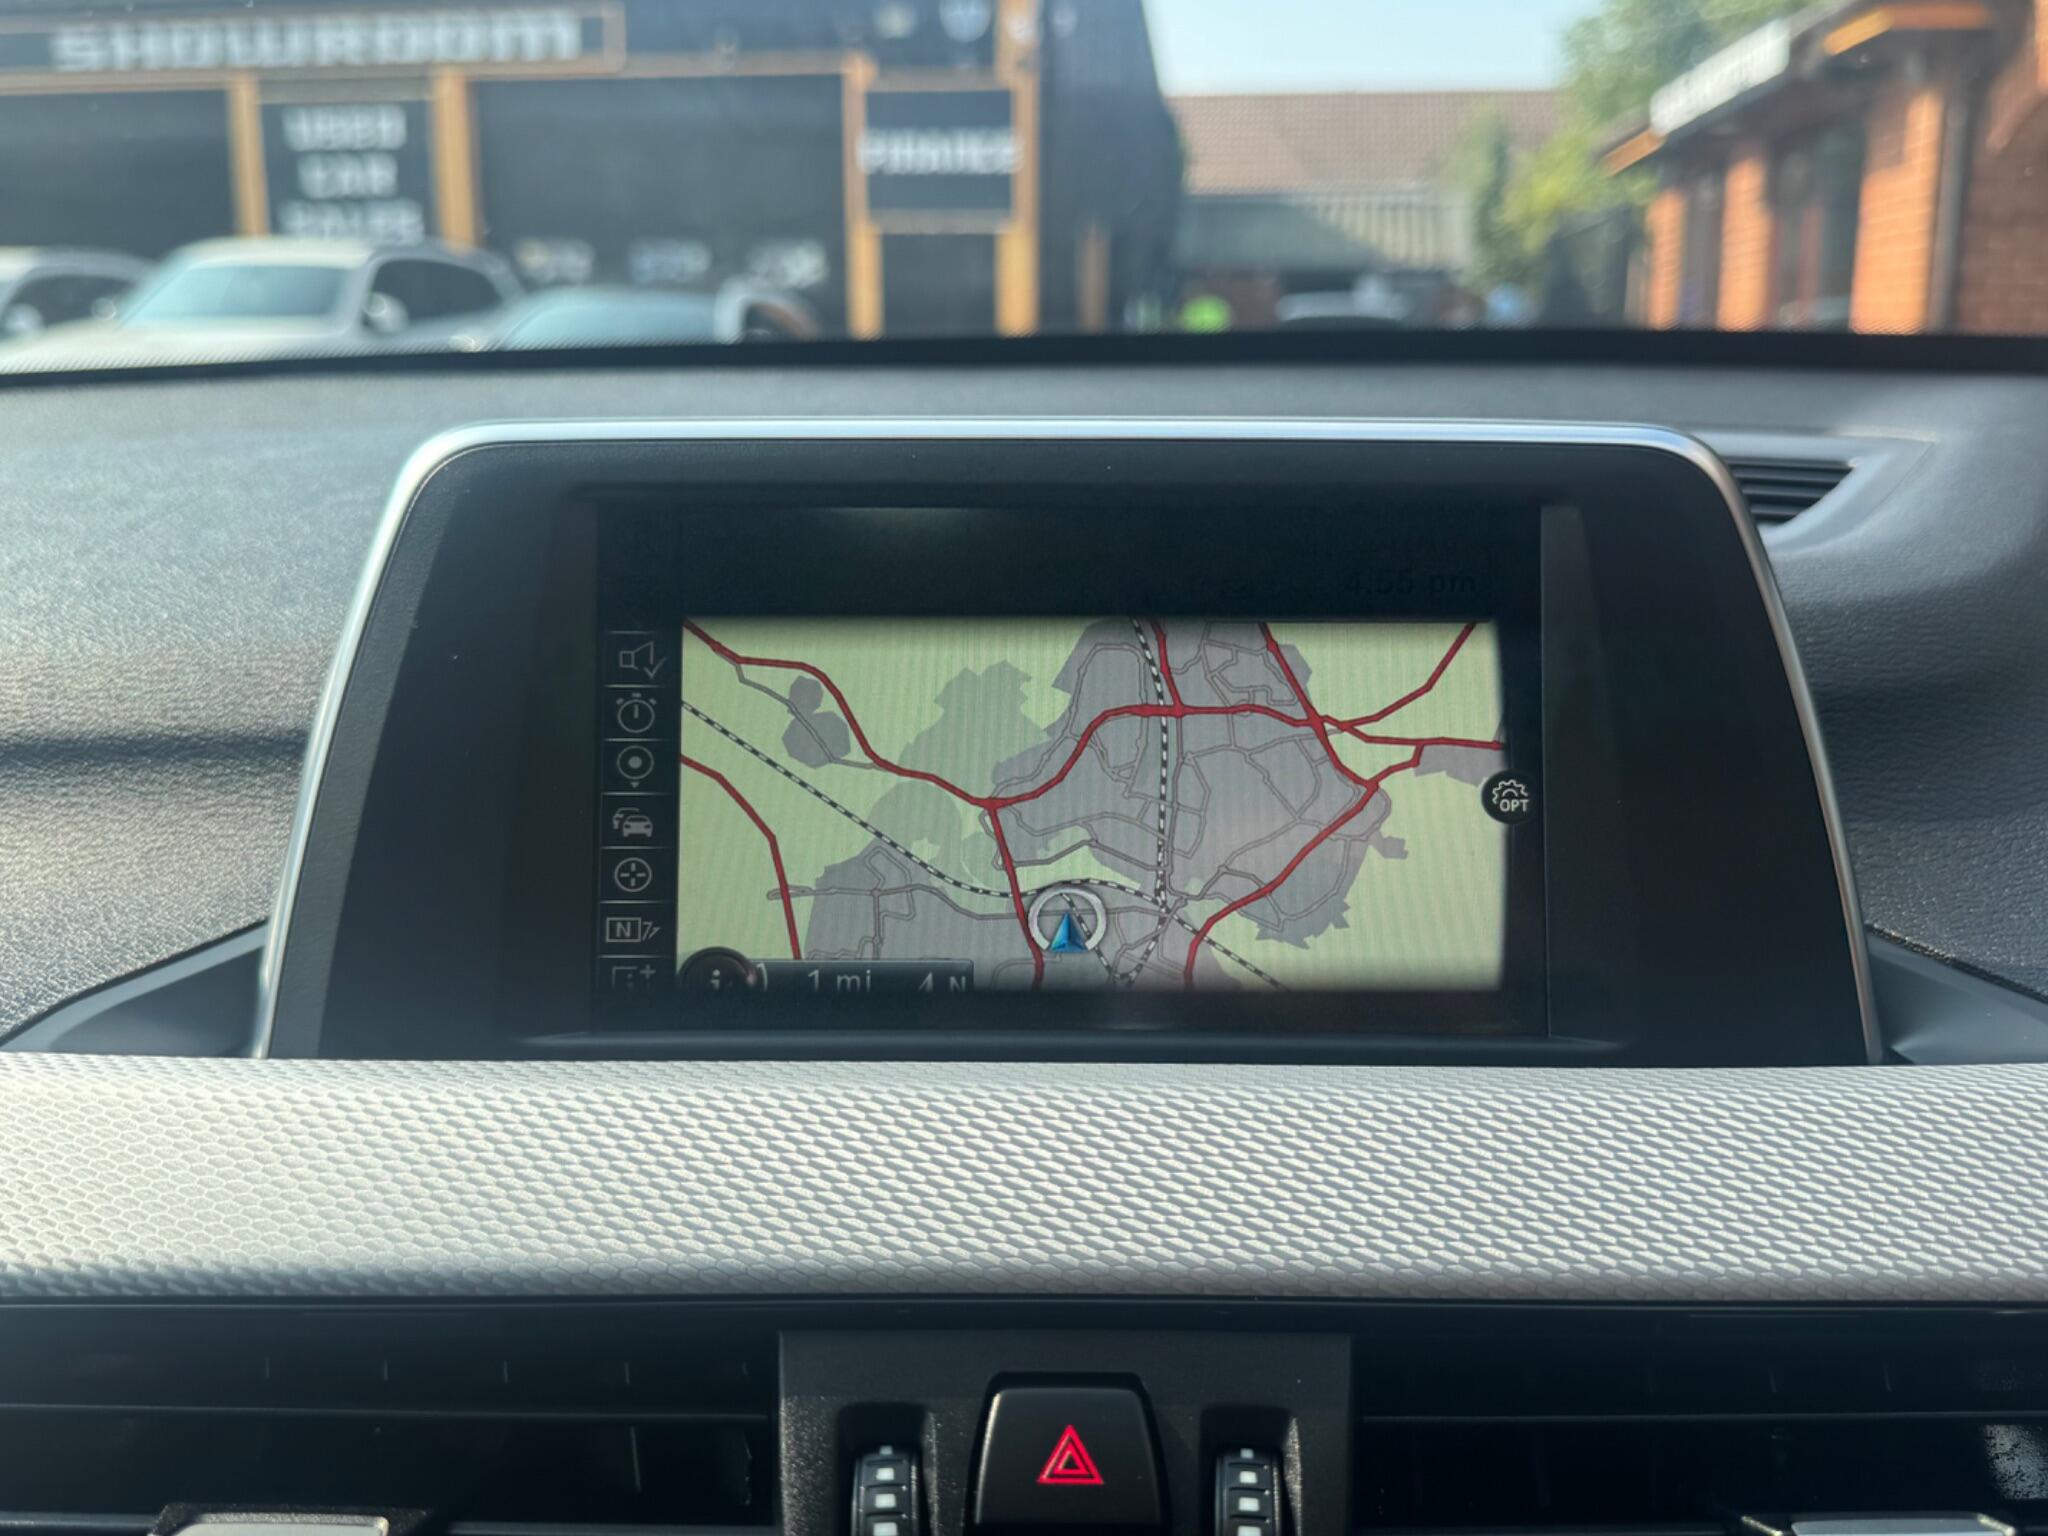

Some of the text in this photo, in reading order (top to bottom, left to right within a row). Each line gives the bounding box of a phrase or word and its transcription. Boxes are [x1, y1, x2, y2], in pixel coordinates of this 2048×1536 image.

[50, 10, 582, 72] SHOWROOM
[1429, 574, 1477, 598] pm
[1499, 799, 1529, 812] OPT
[836, 969, 871, 992] mi
